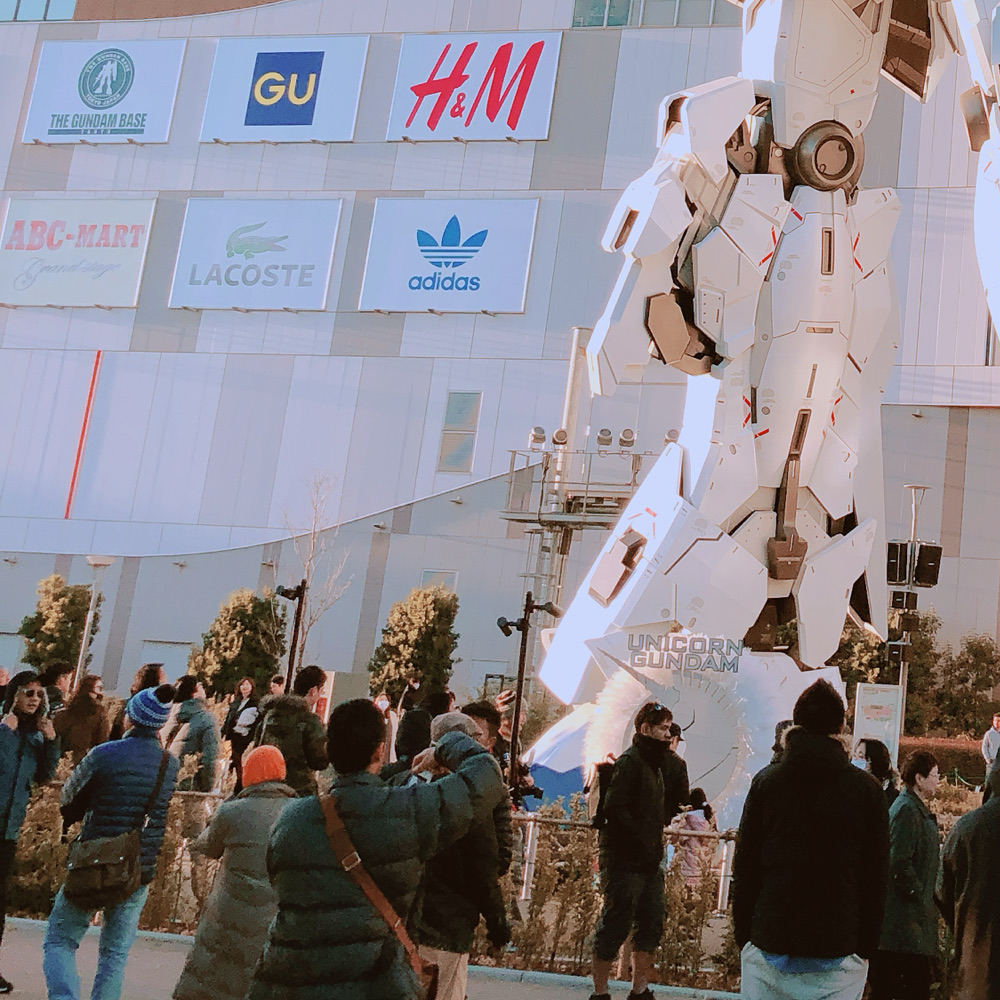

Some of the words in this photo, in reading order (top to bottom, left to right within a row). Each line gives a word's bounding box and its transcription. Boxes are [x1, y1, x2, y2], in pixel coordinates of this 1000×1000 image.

[254, 72, 317, 106] GU
[405, 40, 545, 131] H&M
[50, 113, 70, 128] THE
[71, 113, 117, 128] GUNDAM
[118, 112, 147, 128] BASE
[5, 220, 146, 251] ABC-MART
[189, 264, 316, 287] LACOSTE
[408, 272, 481, 291] adidas
[628, 633, 744, 657] UNICORN
[630, 650, 739, 673] GUNDAM
